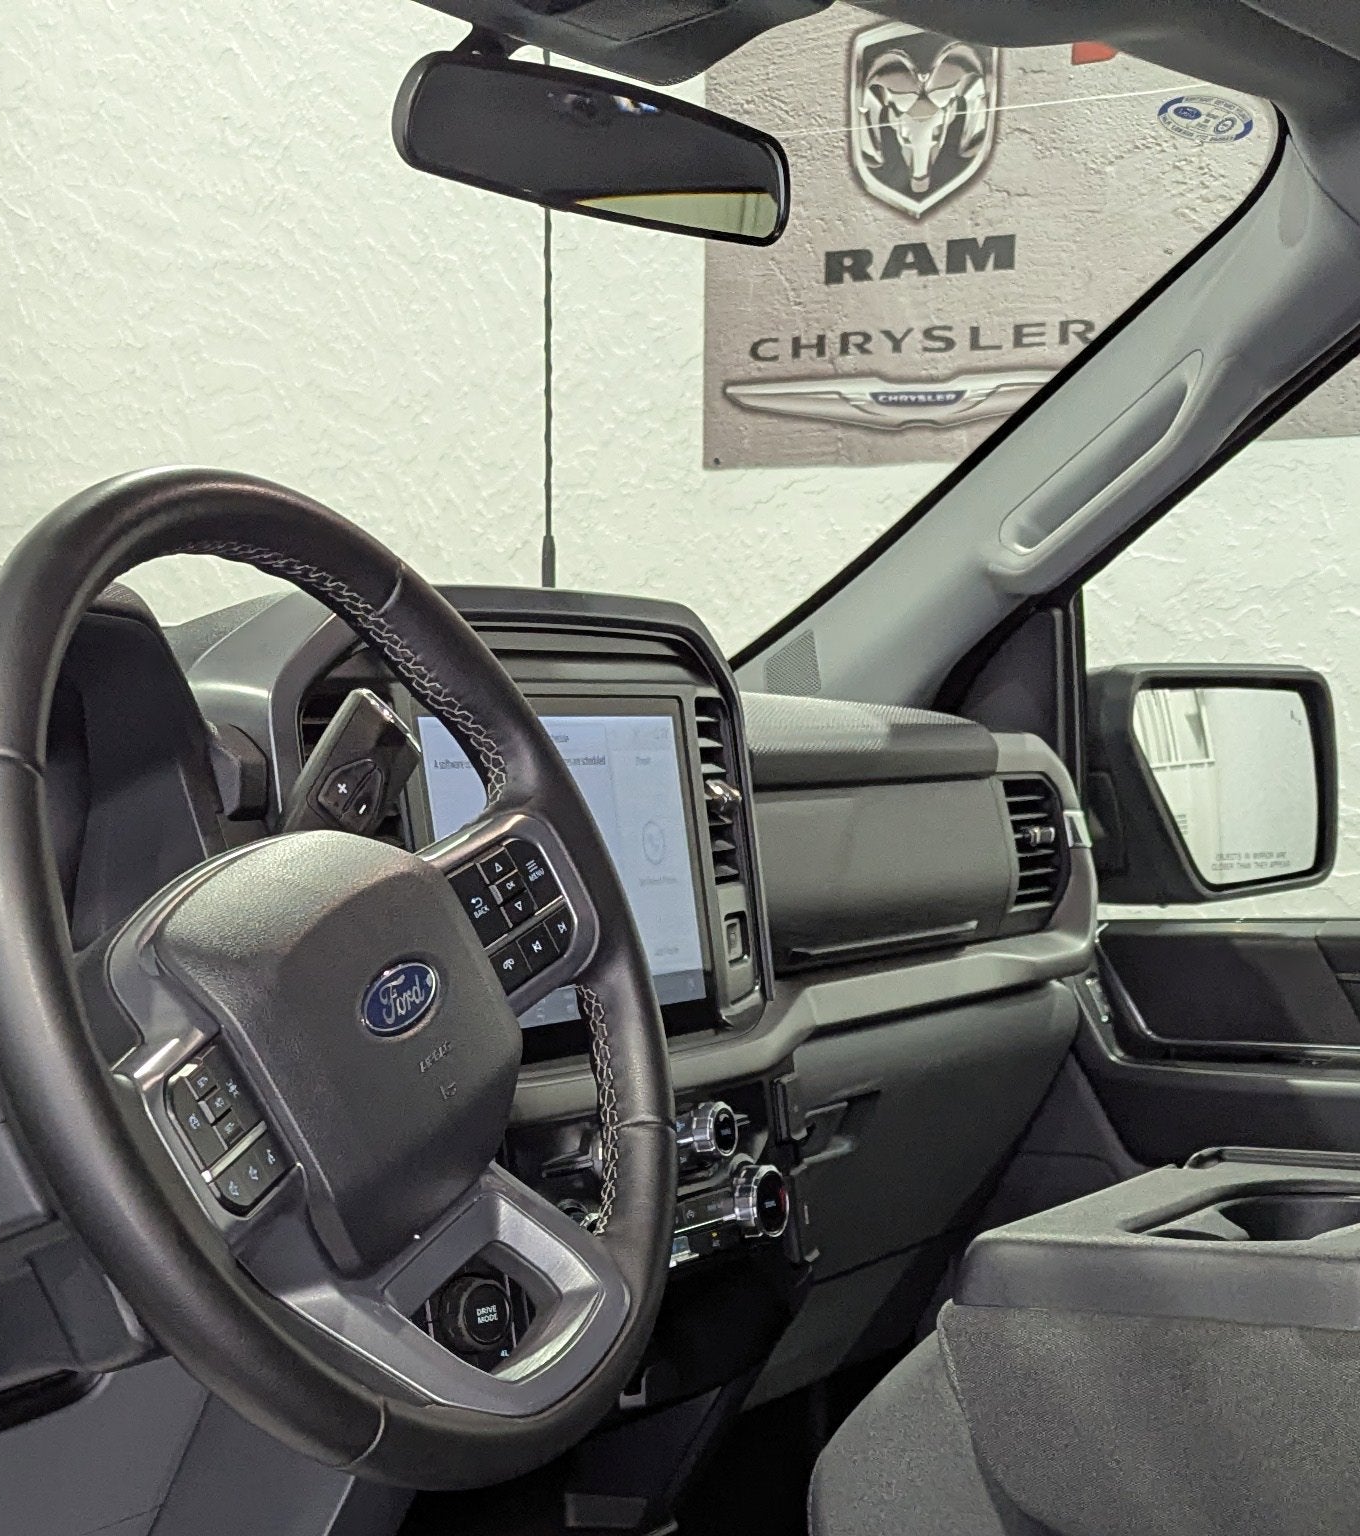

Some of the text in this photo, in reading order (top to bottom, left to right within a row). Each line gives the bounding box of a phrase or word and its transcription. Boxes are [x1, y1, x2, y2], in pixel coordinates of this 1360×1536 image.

[823, 234, 1017, 286] RAM
[748, 318, 1096, 362] CHRYSLER
[878, 393, 957, 403] CHRYSLER
[473, 904, 490, 919] BACK
[378, 974, 425, 1025] Ford
[476, 1304, 497, 1317] DRIVE
